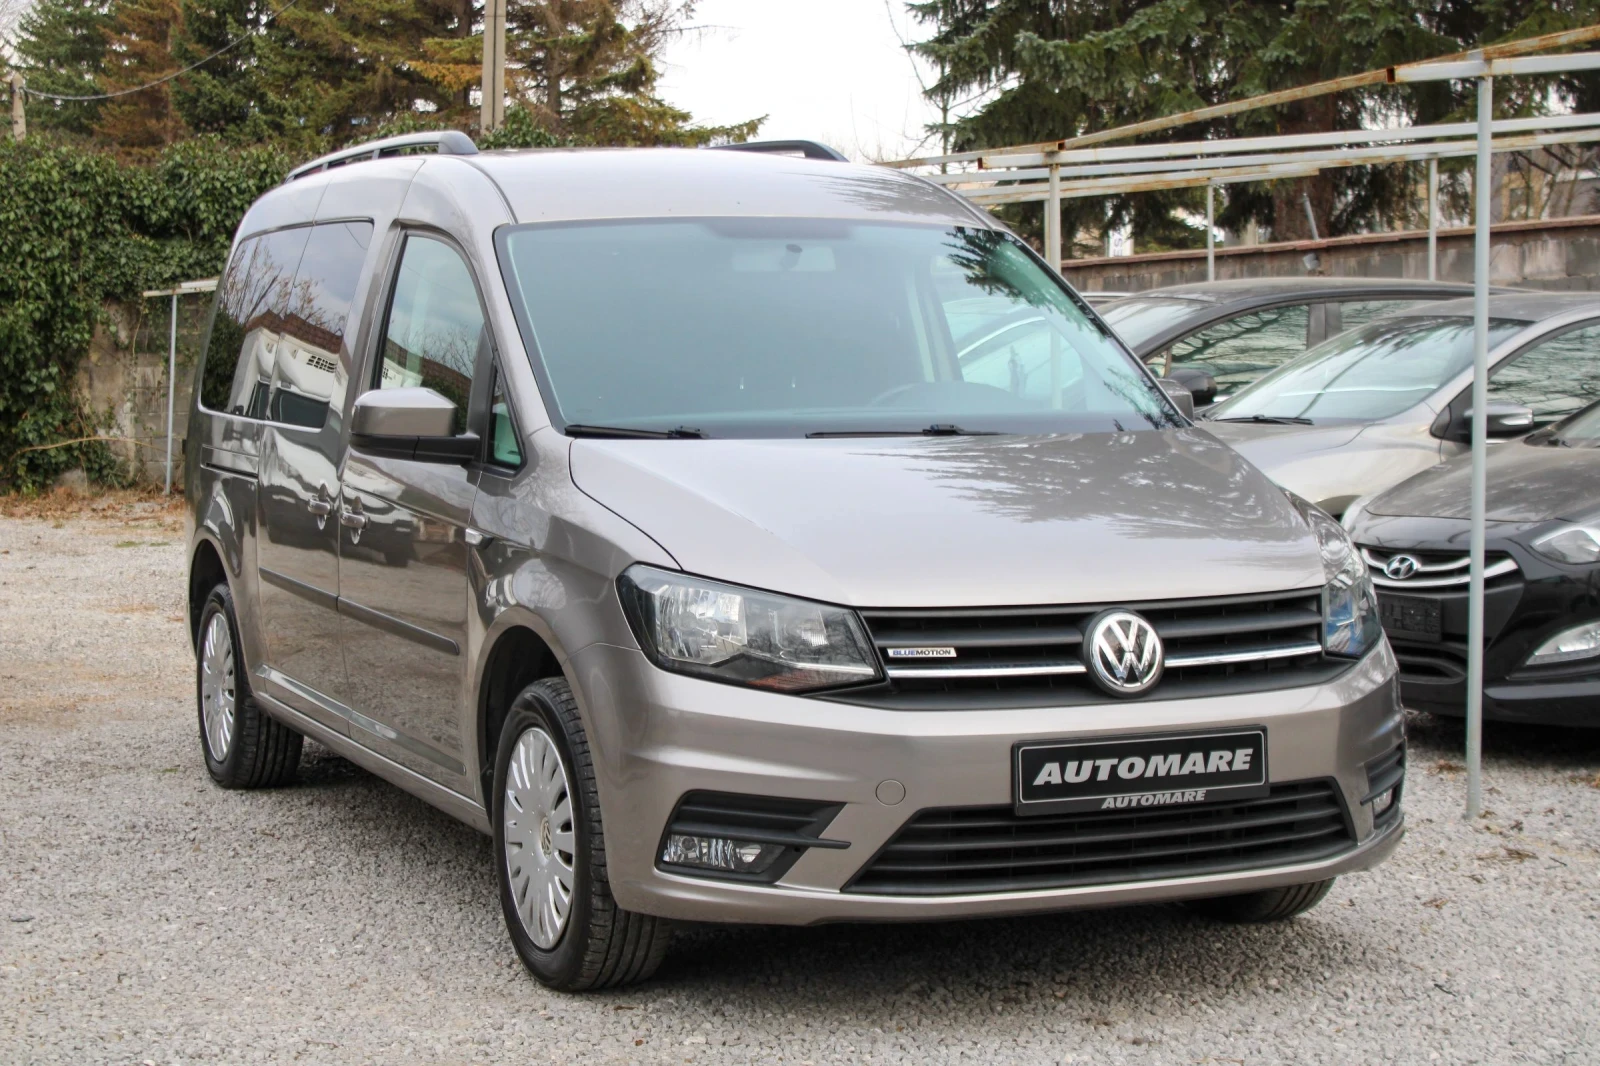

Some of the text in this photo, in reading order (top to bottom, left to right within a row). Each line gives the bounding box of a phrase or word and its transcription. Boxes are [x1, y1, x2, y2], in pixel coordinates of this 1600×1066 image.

[892, 648, 951, 656] BLUEMOTION
[1032, 748, 1254, 786] AUTOMARE
[1101, 790, 1206, 809] AUTOMARE
